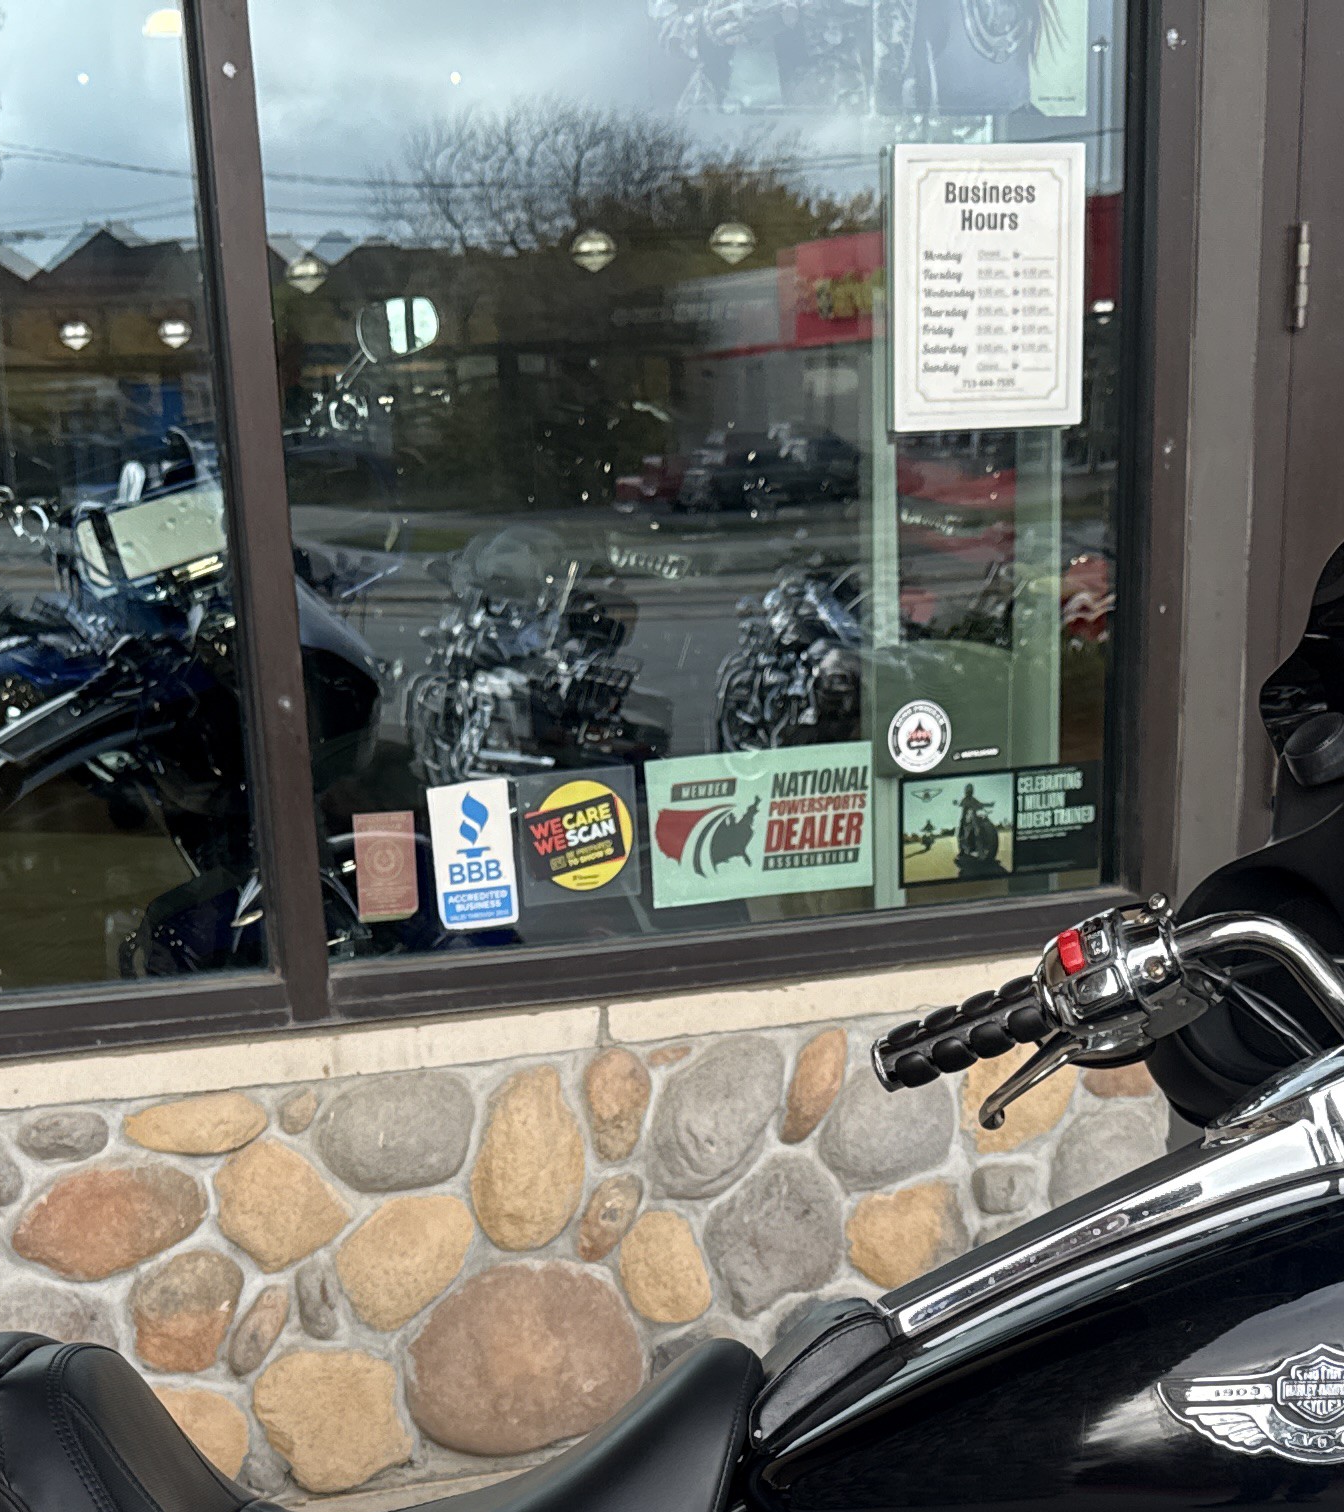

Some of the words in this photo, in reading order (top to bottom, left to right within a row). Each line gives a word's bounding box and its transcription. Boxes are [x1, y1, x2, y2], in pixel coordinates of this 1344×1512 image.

[944, 181, 1036, 204] Business
[961, 208, 1019, 231] Hours
[680, 781, 730, 800] MEMBER
[771, 765, 869, 799] NATIONAL
[1017, 771, 1084, 793] CELEBRATING
[768, 793, 867, 817] POWERSPORTS
[1024, 791, 1066, 811] MILLION
[529, 817, 564, 839] WE
[562, 802, 613, 830] CARE
[1017, 809, 1053, 829] RIDERS
[1053, 804, 1097, 826] TRAINED
[533, 833, 567, 856] WE
[565, 818, 616, 847] SCAN
[764, 811, 864, 854] DEALER
[448, 859, 503, 885] BBB
[448, 889, 509, 904] ACCREDITED
[455, 900, 503, 913] BUSINESS
[1213, 1386, 1261, 1398] 1903
